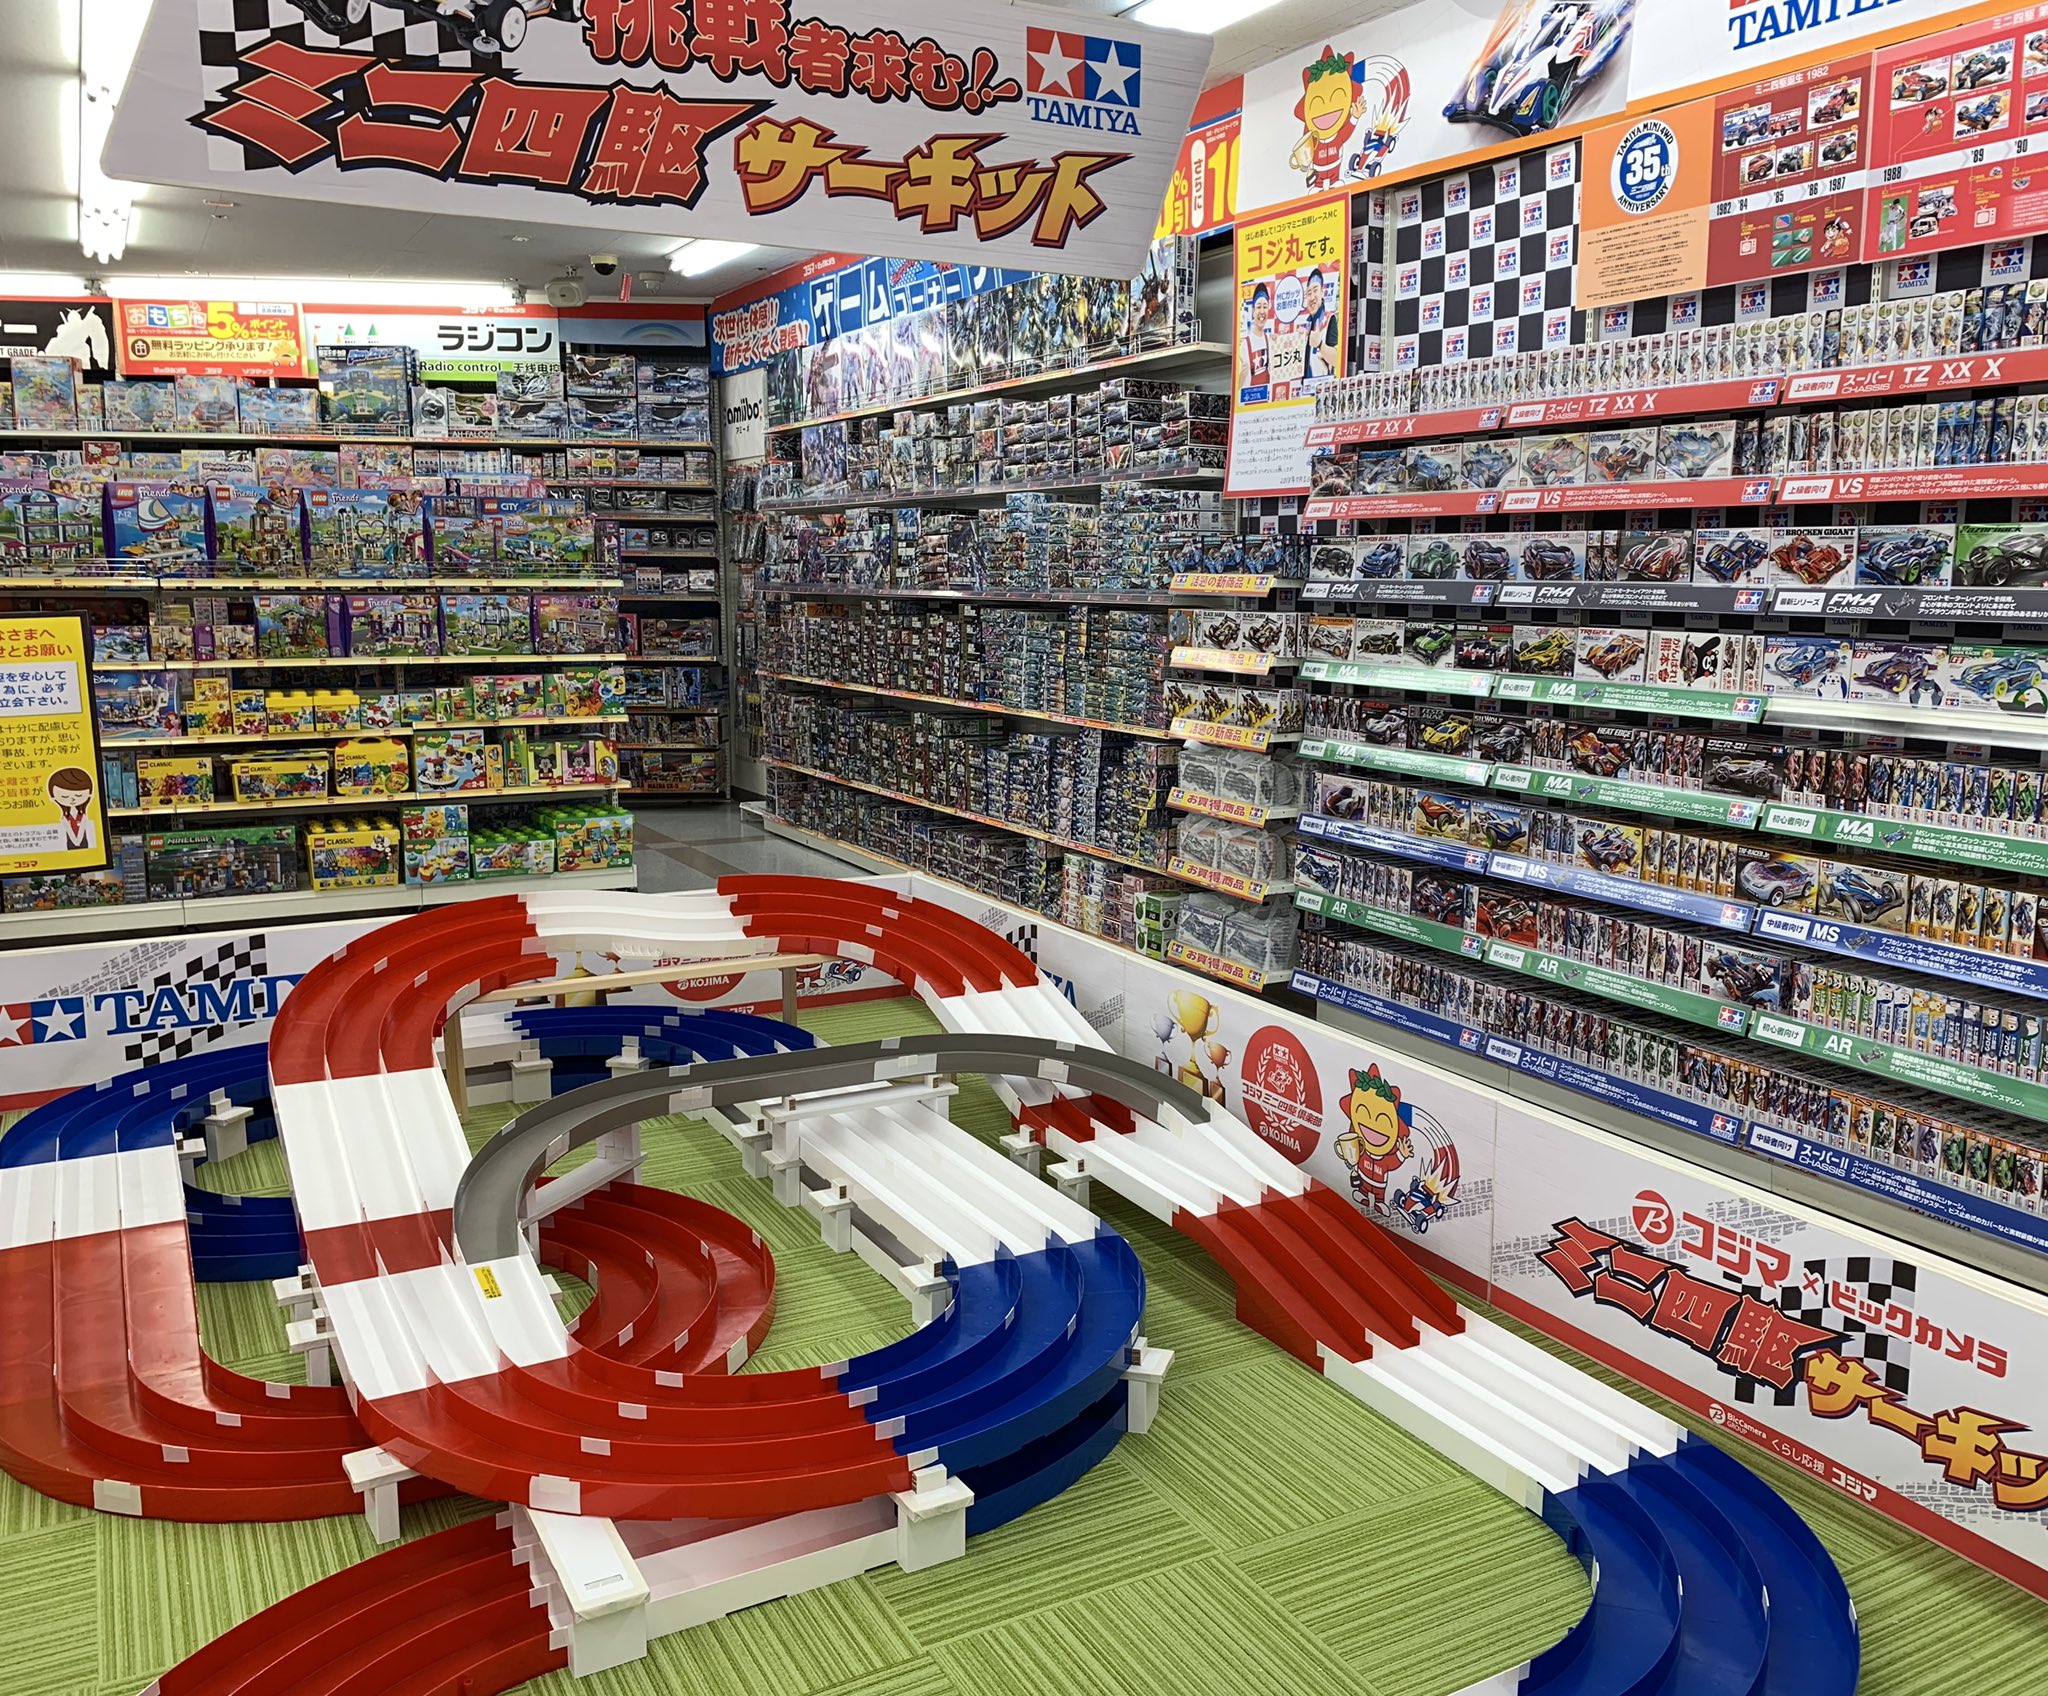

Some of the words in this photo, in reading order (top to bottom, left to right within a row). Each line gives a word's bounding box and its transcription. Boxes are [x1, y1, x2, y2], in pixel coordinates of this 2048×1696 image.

[1806, 66, 1828, 81] 1982
[190, 38, 768, 206] ミニ四駆
[1027, 96, 1142, 135] TAMIYA
[1617, 127, 1642, 157] TAMIYA
[1642, 121, 1661, 132] MINI
[1660, 126, 1674, 145] 4WD
[2015, 138, 2028, 153] '90
[1971, 148, 1984, 163] '89
[1626, 145, 1671, 186] 35th
[734, 117, 1135, 246] サーキット
[1883, 166, 1902, 182] 1988
[1194, 158, 1204, 211] さらに
[1807, 182, 1818, 197] '86
[1829, 176, 1846, 192] 1987
[1618, 182, 1669, 214] ANNIVERSARY
[1738, 198, 1748, 211] '84
[1773, 190, 1784, 204] '85
[1716, 201, 1731, 216] 1982
[1247, 233, 1335, 273] コジ丸です。
[1989, 264, 2022, 275] TAMIYA
[1897, 278, 1928, 289] TAMIYA
[813, 267, 890, 338] ゲーム
[894, 274, 962, 317] コーナー
[1813, 293, 1839, 303] TAMIYA
[1741, 304, 1766, 314] TAMIYA
[128, 307, 204, 328] おもちゃ
[208, 301, 249, 339] 5%
[250, 318, 288, 329] ポイント
[1672, 314, 1696, 324] TAMIYA
[1604, 323, 1628, 333] TAMIYA
[151, 339, 272, 352] 無料ラッピング承ります!
[437, 324, 553, 353] ラジコン
[1273, 348, 1302, 368] コジ丸
[419, 360, 455, 372] Radio
[457, 361, 501, 372] control
[1902, 365, 1932, 382] TZ
[1938, 360, 1975, 379] XX
[1981, 357, 2006, 377] X
[1794, 380, 1835, 393] 上級者向け
[1841, 382, 1891, 394] CHASSIS
[1589, 397, 1609, 412] TZ
[1613, 395, 1636, 411] XX
[1642, 392, 1658, 409] X
[726, 402, 760, 425] amiibo
[1365, 423, 1380, 435] TZ
[1384, 421, 1400, 434] XX
[1404, 419, 1415, 433] X
[117, 488, 133, 498] LEGO
[138, 486, 171, 499] Friends
[218, 489, 231, 498] LEGO
[1786, 484, 1829, 497] 上級者向け
[1838, 477, 1864, 495] VS
[233, 489, 257, 499] Friends
[312, 493, 328, 503] LEGO
[331, 492, 360, 503] Friends
[1544, 490, 1563, 505] VS
[485, 503, 498, 511] LEGO
[501, 502, 519, 512] CITY
[1334, 501, 1349, 513] VS
[1785, 528, 1824, 537] BROCKEN
[1825, 527, 1856, 536] GIGANT
[1960, 525, 2023, 534] Razorback
[1190, 575, 1250, 589] 話題の新商品!
[1331, 582, 1360, 594] FM-A
[1537, 586, 1577, 599] FM-A
[1828, 592, 1883, 608] FM-A
[1536, 597, 1570, 605] CHASSIS
[1779, 595, 1821, 608] 最新シリーズ
[1826, 606, 1875, 615] CHASSIS
[1549, 682, 1577, 697] MA
[1191, 722, 1249, 744] 話題の新商品!
[1597, 727, 1613, 736] HEAT
[1613, 729, 1632, 738] EDGE
[1337, 744, 1357, 757] MA
[150, 760, 173, 768] CLASSIC
[250, 765, 272, 773] CLASSIC
[1544, 775, 1573, 790] MA
[1186, 794, 1247, 818] お買得商品
[1773, 813, 1810, 828] 初心者向け
[1836, 818, 1874, 837] MA
[150, 837, 164, 848] LEGO
[326, 837, 355, 846] CLASSIC
[14, 860, 38, 869] コジマ
[1527, 863, 1549, 879] MS
[1186, 863, 1246, 891] お買得商品
[1331, 900, 1348, 915] AR
[1766, 918, 1806, 934] 中級者向け
[1812, 923, 1841, 943] MS
[1186, 949, 1245, 979] お買得商品
[1537, 959, 1559, 976] AR
[690, 976, 730, 988] KOJIMA
[1762, 1022, 1800, 1040] 初心者向け
[1824, 1034, 1853, 1056] AR
[1520, 1062, 1555, 1079] CHASSIS
[1242, 1081, 1323, 1128] コジマミニ四駆倶楽部
[1269, 1128, 1301, 1153] KOJIMA
[1710, 1128, 1734, 1141] TAMIYA
[1755, 1132, 1794, 1153] 中級者向け
[1799, 1155, 1846, 1178] CHASSIS
[1540, 1218, 1845, 1389] ミニ四駆
[1726, 1411, 1768, 1440] BicCamera
[1727, 1422, 1749, 1435] GROUP
[1771, 1437, 1826, 1477] くらし応援
[1832, 1465, 1879, 1501] コジマ
